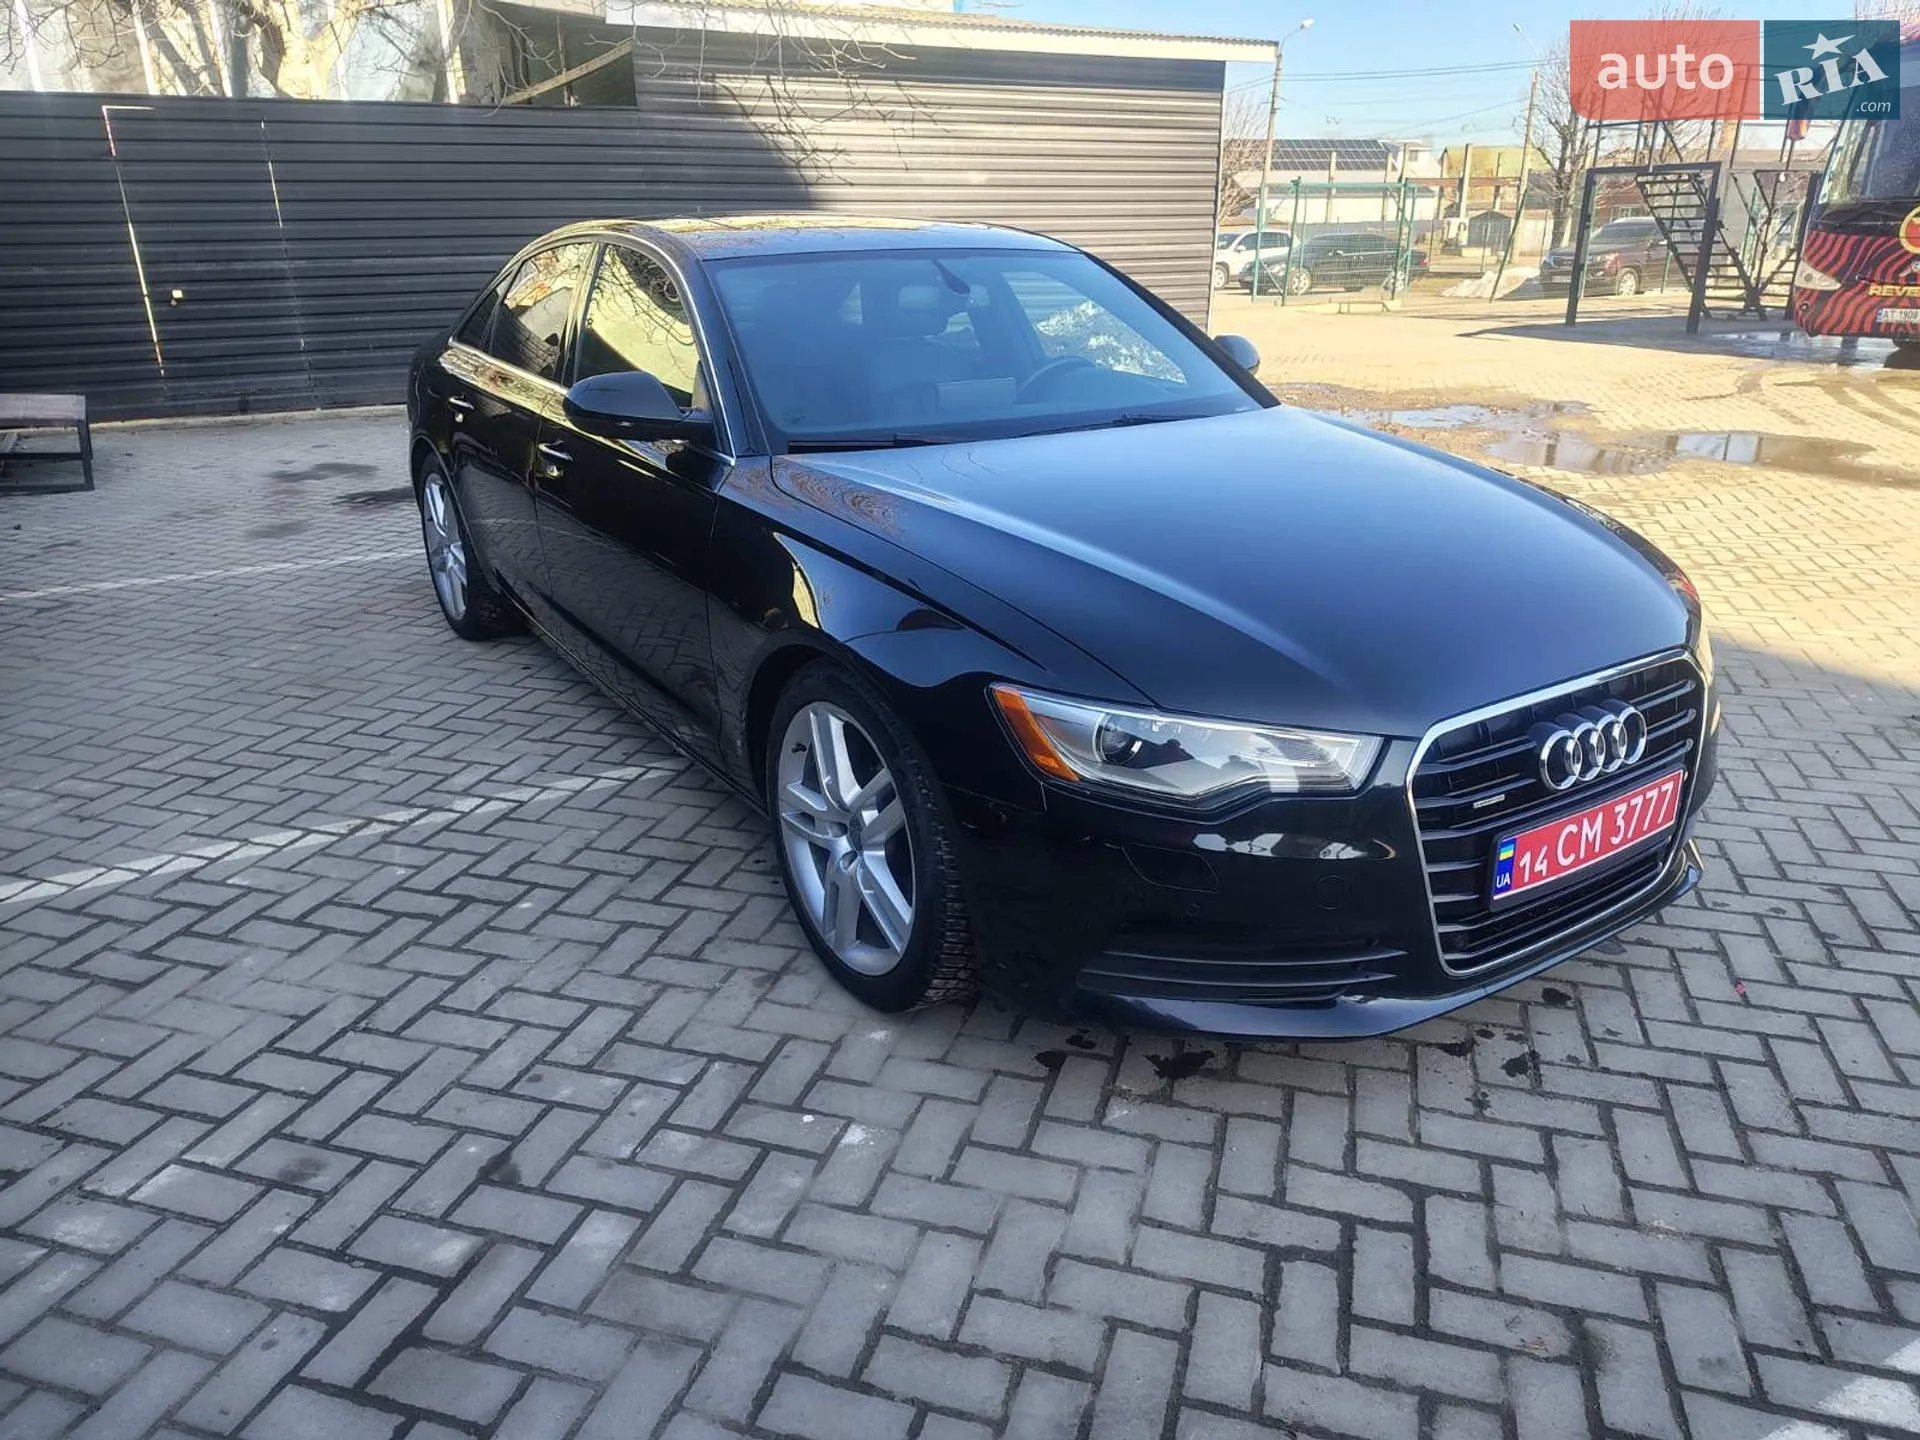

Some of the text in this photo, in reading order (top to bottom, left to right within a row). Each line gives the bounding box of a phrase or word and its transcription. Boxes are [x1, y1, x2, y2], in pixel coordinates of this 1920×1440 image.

[1519, 781, 1675, 882] 14 CM 3777
[1496, 874, 1511, 888] UA
